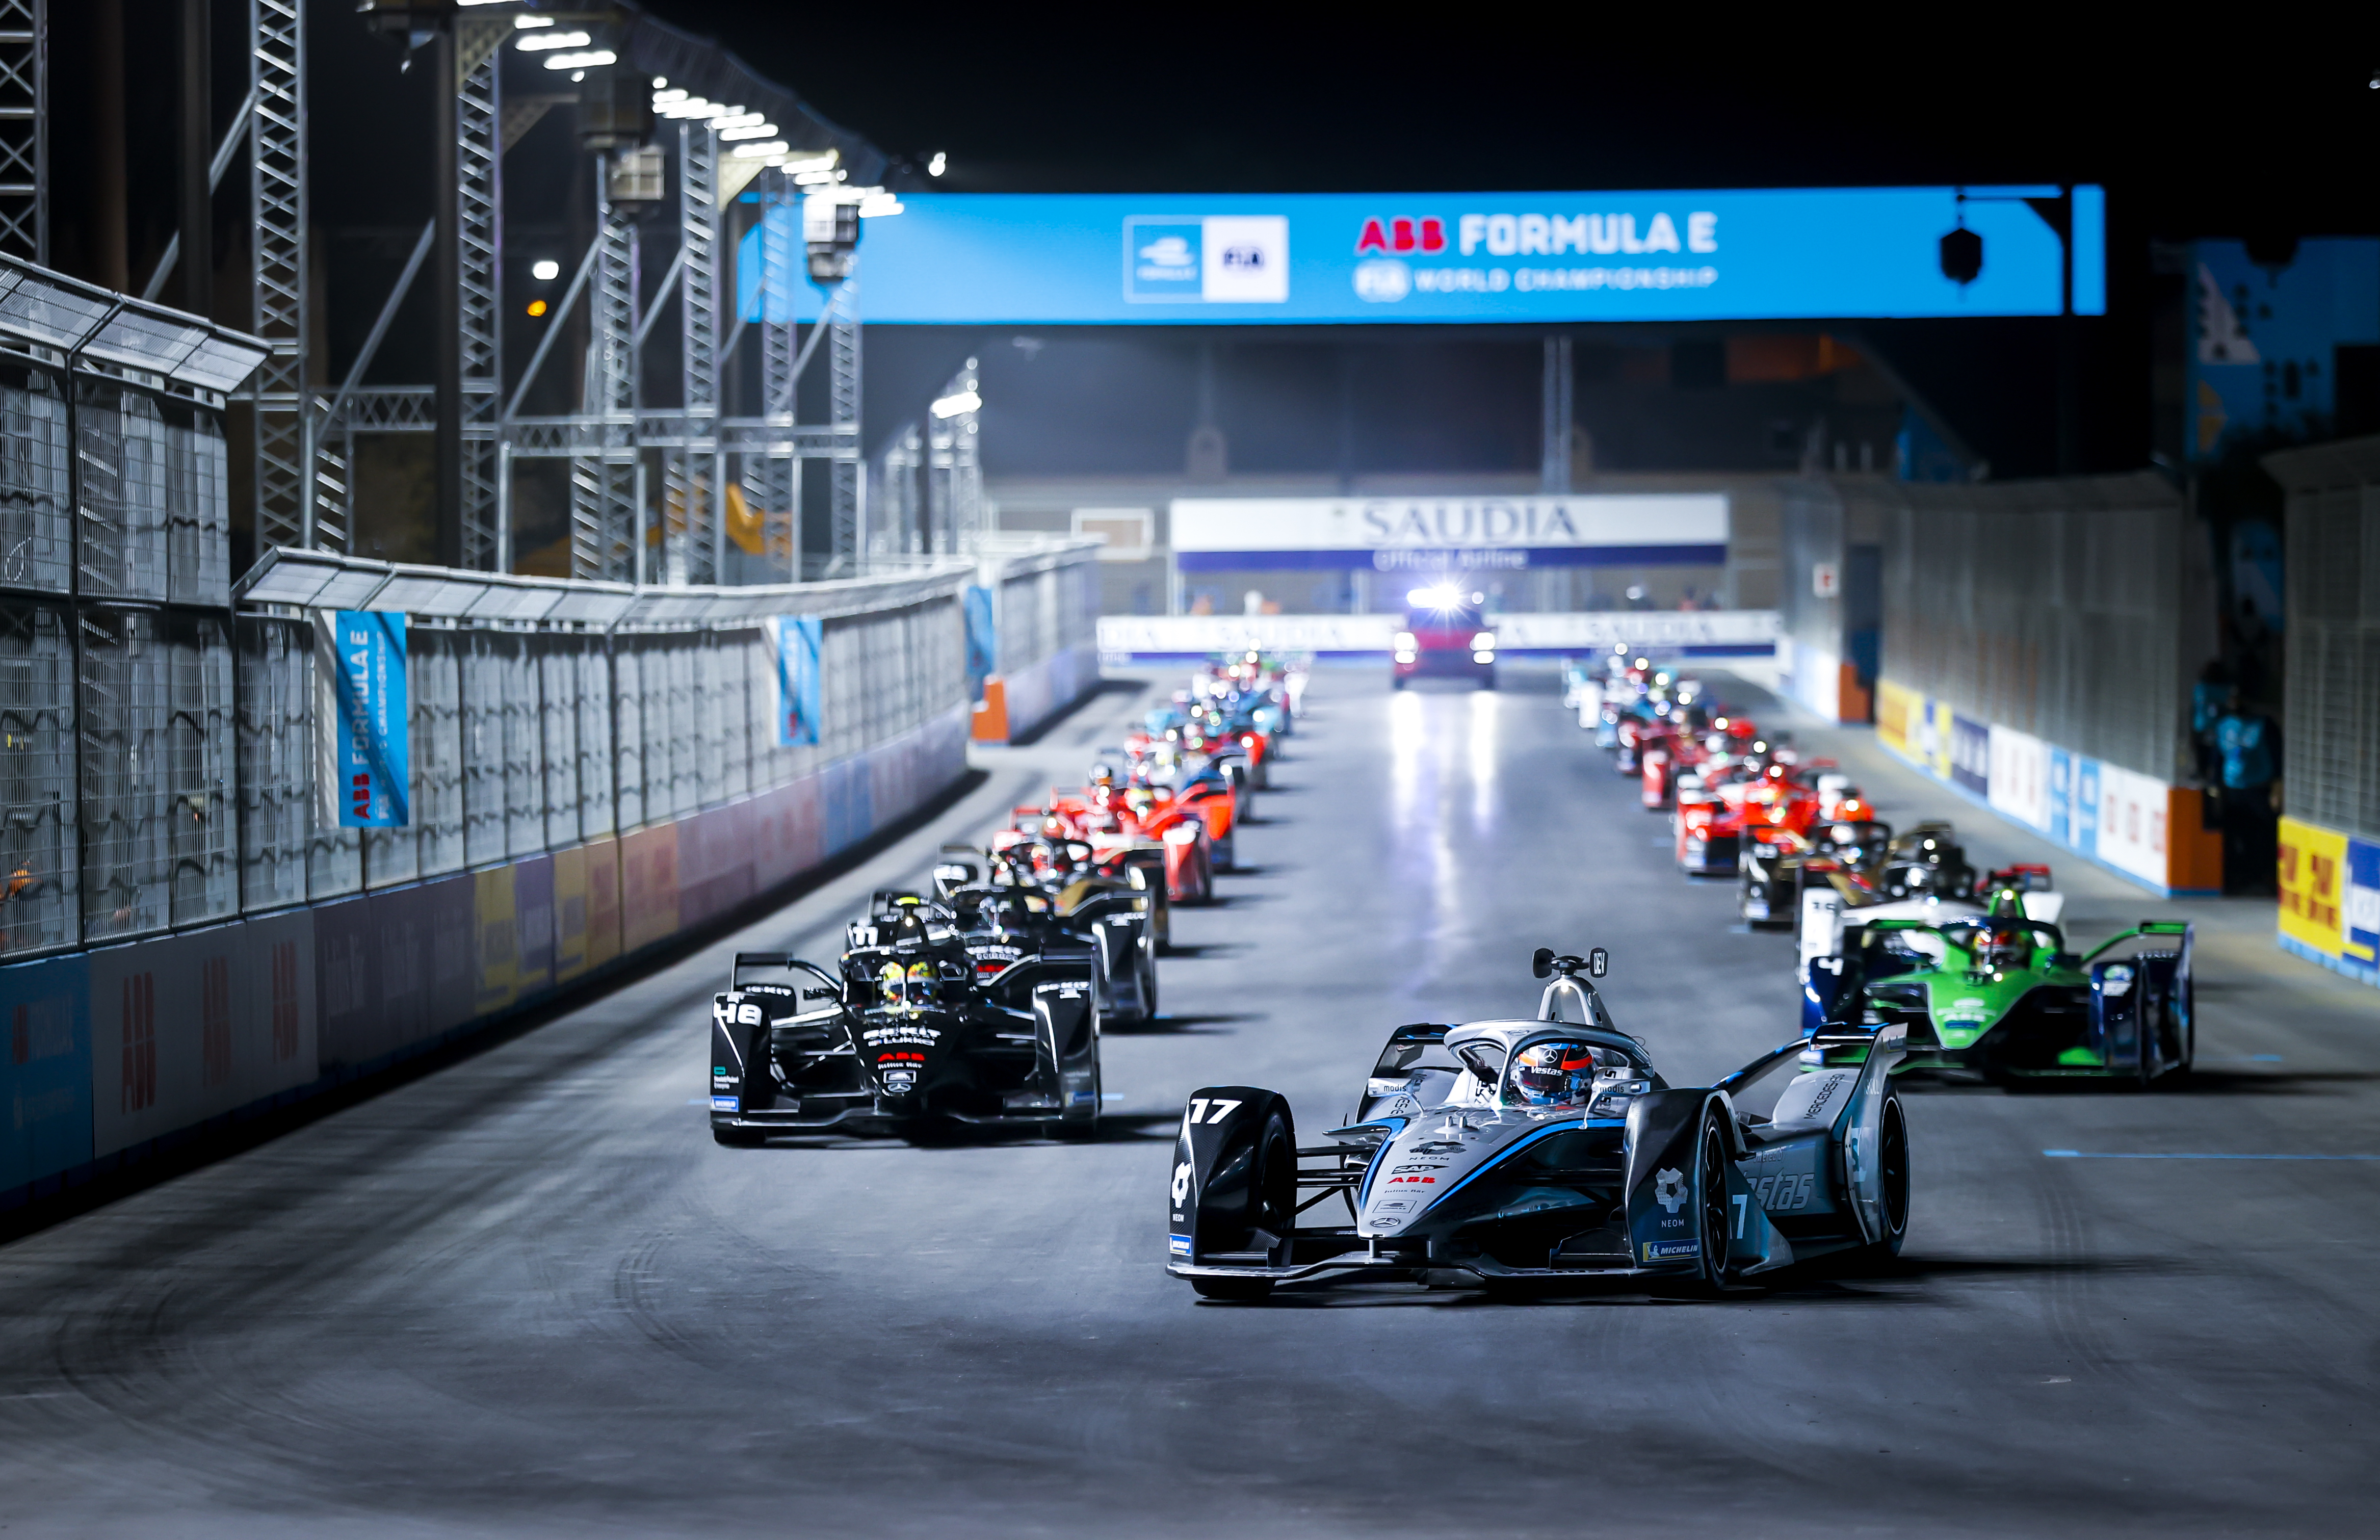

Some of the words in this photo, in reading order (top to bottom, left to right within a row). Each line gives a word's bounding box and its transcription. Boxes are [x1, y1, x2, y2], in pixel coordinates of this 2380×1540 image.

[1357, 219, 1444, 252] ABB
[1459, 213, 1681, 255] FORMULA
[1688, 211, 1718, 253] E
[1514, 266, 1718, 292] CHAMPIONSHIP
[1363, 500, 1577, 542] SAUDIA
[350, 630, 369, 645] E
[351, 649, 369, 765] FORMULA
[352, 773, 371, 820] ABB
[1594, 952, 1605, 974] DEV
[121, 971, 156, 1115] ABB
[877, 1052, 925, 1062] ABB
[1531, 1066, 1563, 1076] Vestas
[1383, 1084, 1407, 1092] modis
[1600, 1084, 1625, 1092] modis
[1190, 1099, 1242, 1124] 17
[1743, 1167, 1815, 1211] estas
[1172, 1214, 1184, 1222] NEOM
[1661, 1219, 1684, 1228] NEOM
[1661, 1244, 1698, 1255] MICHELIN
